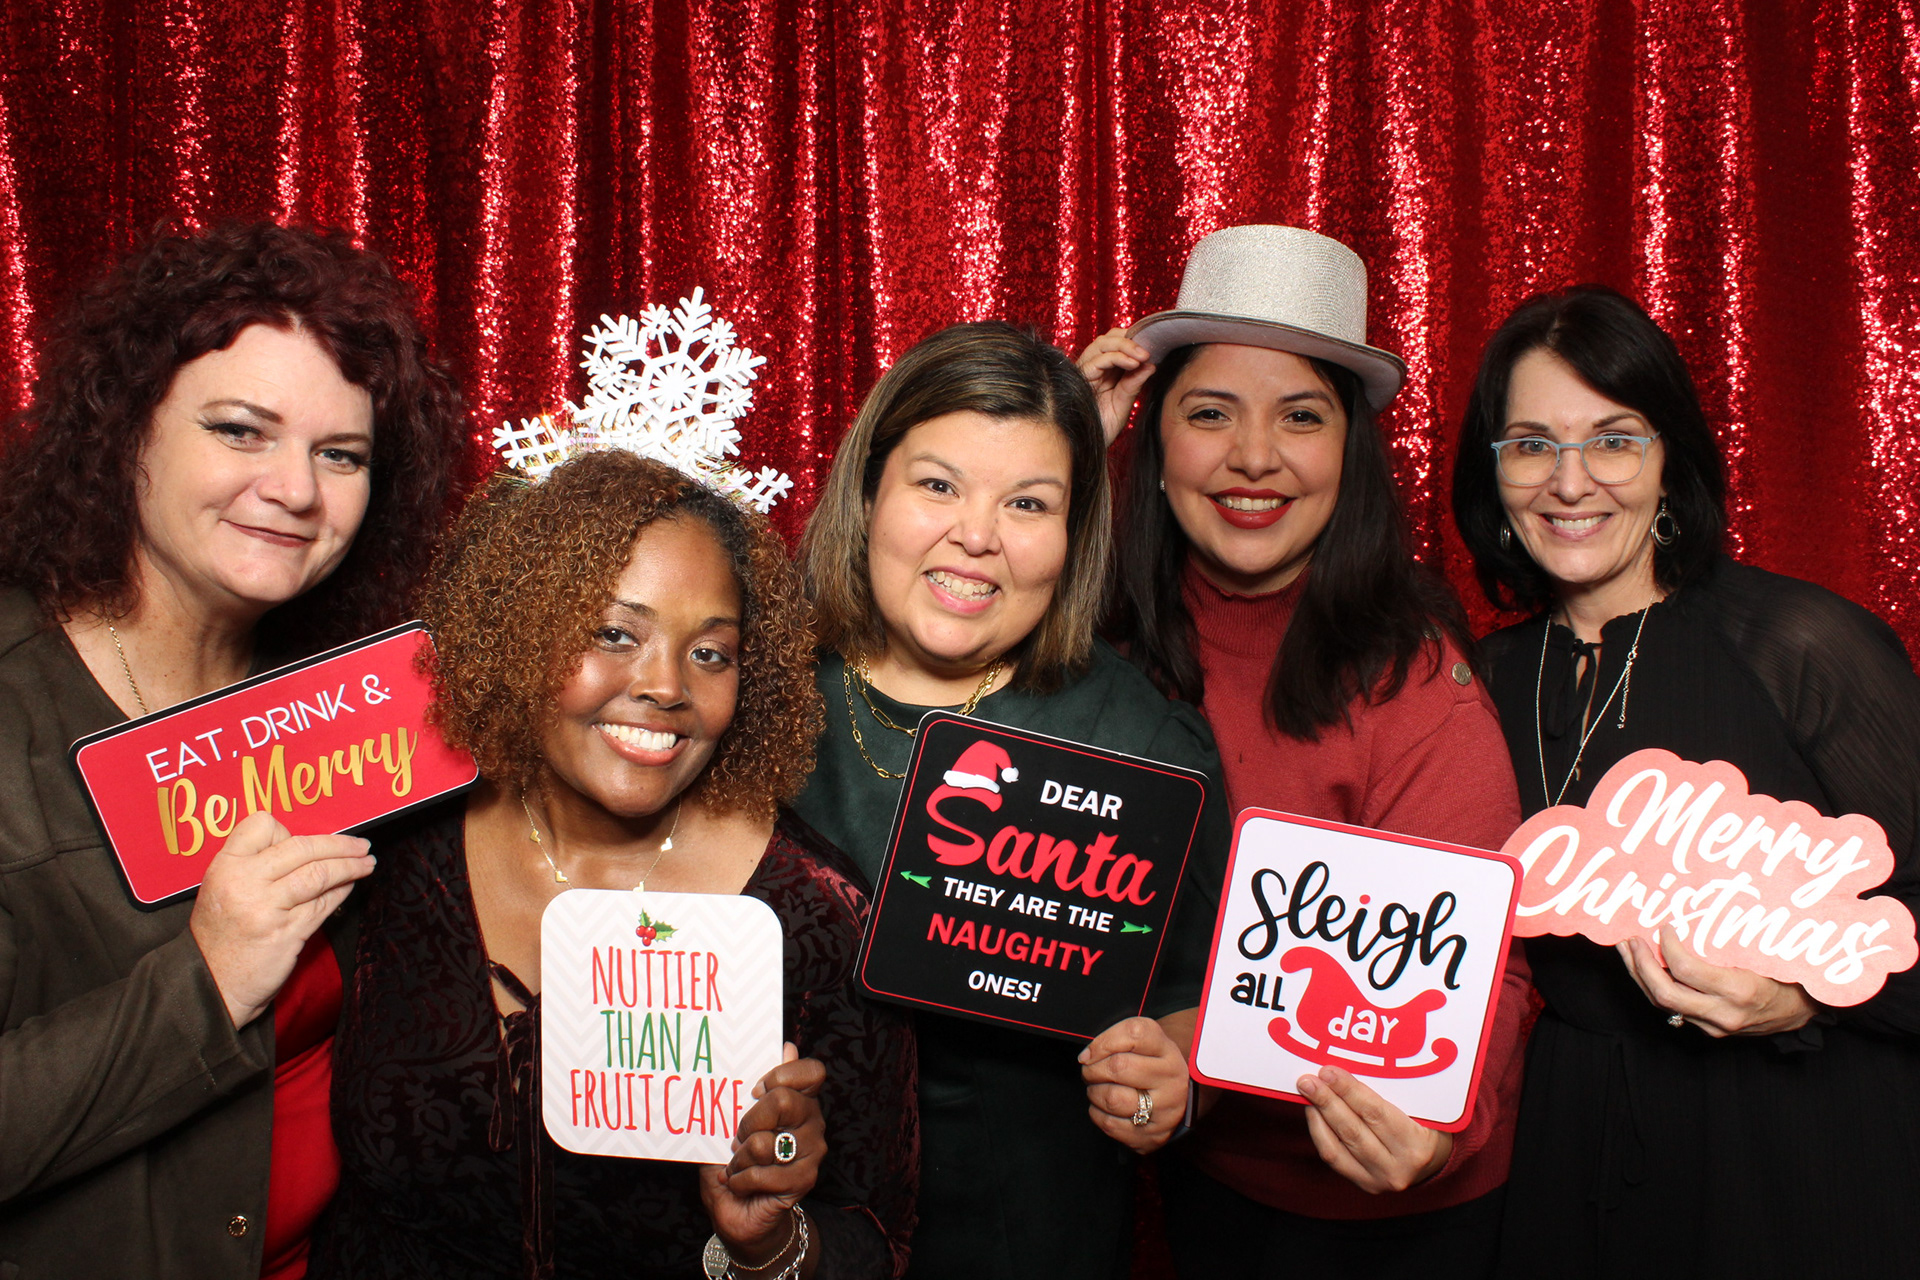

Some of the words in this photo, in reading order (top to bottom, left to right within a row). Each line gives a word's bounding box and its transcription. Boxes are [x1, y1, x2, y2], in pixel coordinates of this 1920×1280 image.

[145, 727, 239, 783] EAT,
[240, 683, 356, 746] DRINK
[361, 673, 392, 705] &
[157, 777, 237, 857] Be
[241, 726, 418, 813] Merry
[1039, 778, 1124, 820] DEAR
[925, 782, 1157, 906] Santa
[1605, 768, 1870, 909] Merry
[943, 876, 1005, 907] THEY
[1008, 892, 1061, 921] ARE
[1067, 904, 1114, 933] THE
[1515, 824, 1893, 985] Christmas
[926, 912, 1105, 976] NAUGHTY
[591, 945, 723, 1012] NUTTIER
[967, 969, 1042, 1003] ONES!
[600, 1009, 681, 1073] THAN
[692, 1015, 713, 1074] A
[569, 1068, 654, 1132] FRUIT
